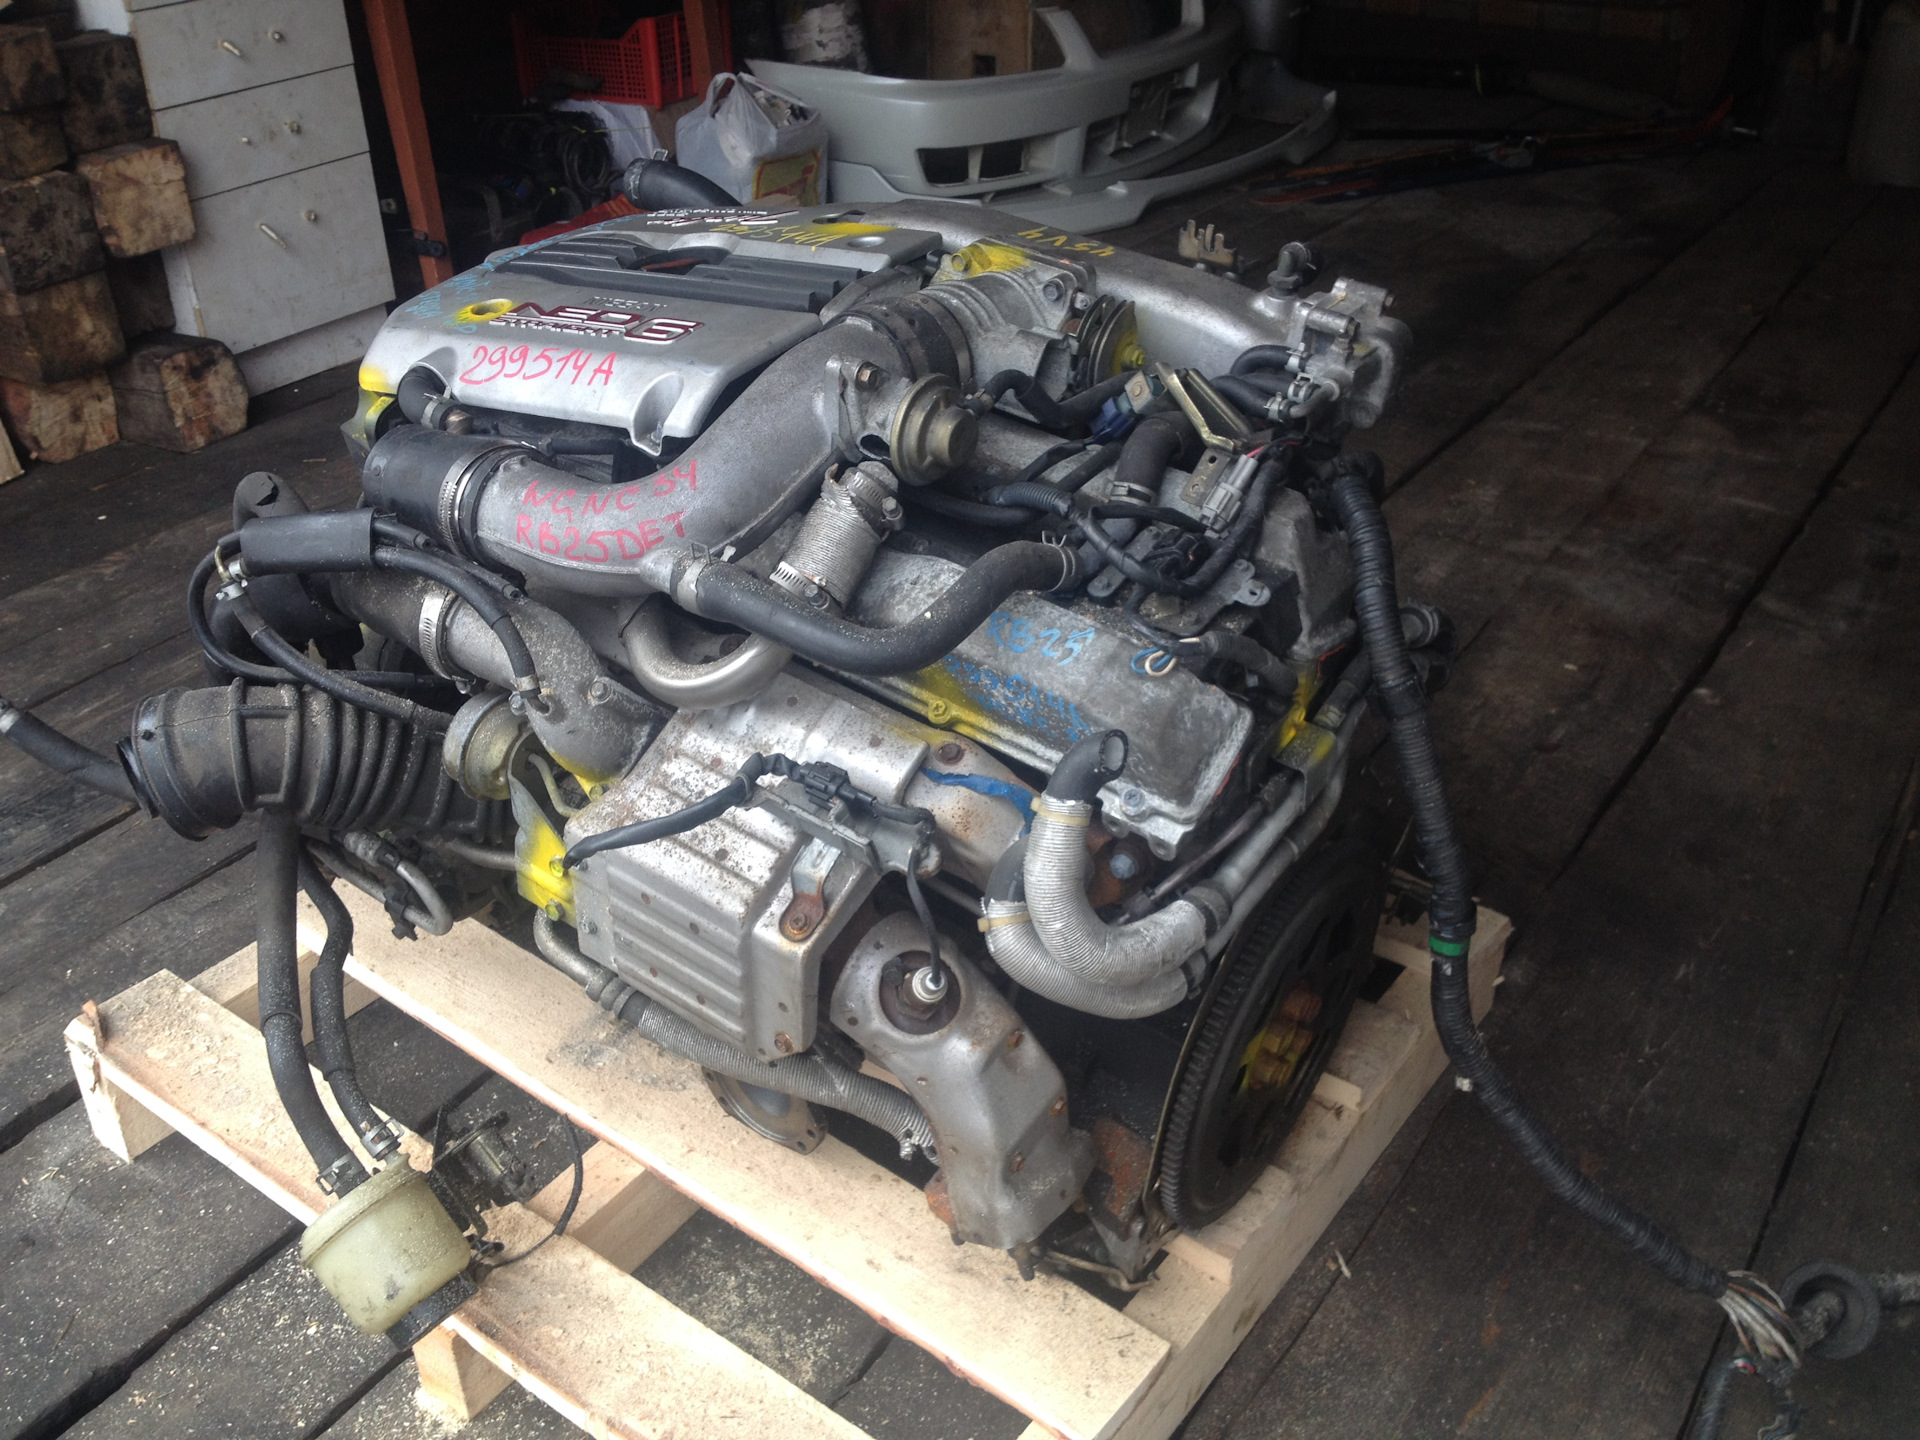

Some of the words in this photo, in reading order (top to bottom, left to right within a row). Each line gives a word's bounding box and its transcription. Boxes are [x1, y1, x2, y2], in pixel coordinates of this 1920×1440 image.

[489, 317, 622, 338] STRAIGHT
[502, 302, 644, 330] NEO
[460, 346, 617, 387] 299514A
[516, 511, 689, 563] RB25DET
[986, 611, 1095, 666] RB25
